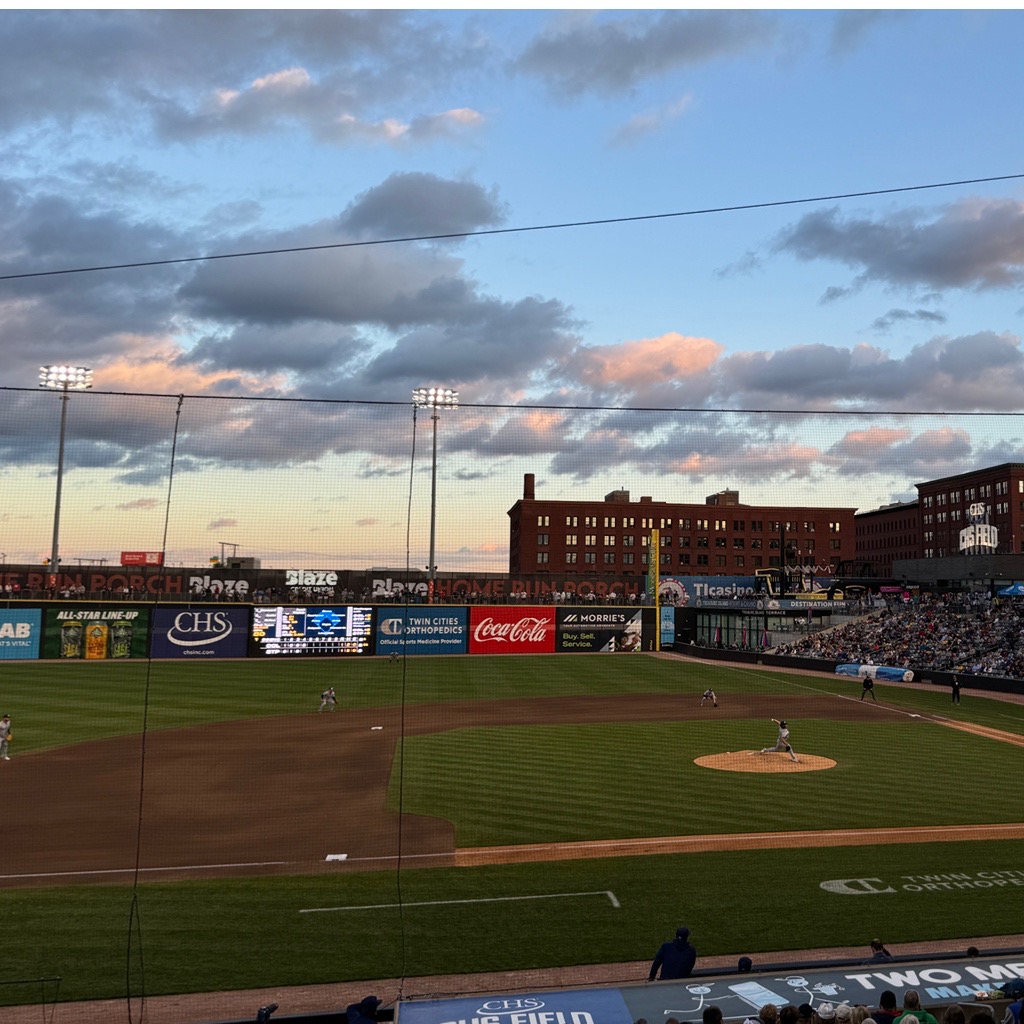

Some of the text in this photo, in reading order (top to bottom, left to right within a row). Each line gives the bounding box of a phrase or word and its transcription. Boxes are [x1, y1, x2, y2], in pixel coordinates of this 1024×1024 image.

[91, 574, 182, 594] PORCH
[189, 575, 249, 594] Blaze
[285, 569, 338, 586] Blaze
[372, 578, 428, 595] Blaze
[437, 579, 639, 597] HOME RUN PORCH
[56, 611, 139, 620] ALL-STAR LINE-UP
[174, 611, 227, 633] CHS
[409, 617, 458, 625] TWIN CITIES
[580, 614, 626, 622] MORRIE'S
[404, 626, 463, 635] ORTHOPEDICS
[474, 617, 551, 642] Coca-Cola
[562, 632, 596, 641] Buy. Sell.
[562, 640, 593, 648] Service.
[901, 872, 974, 883] TWIN
[844, 968, 962, 990] TWO
[483, 997, 540, 1011] CHS
